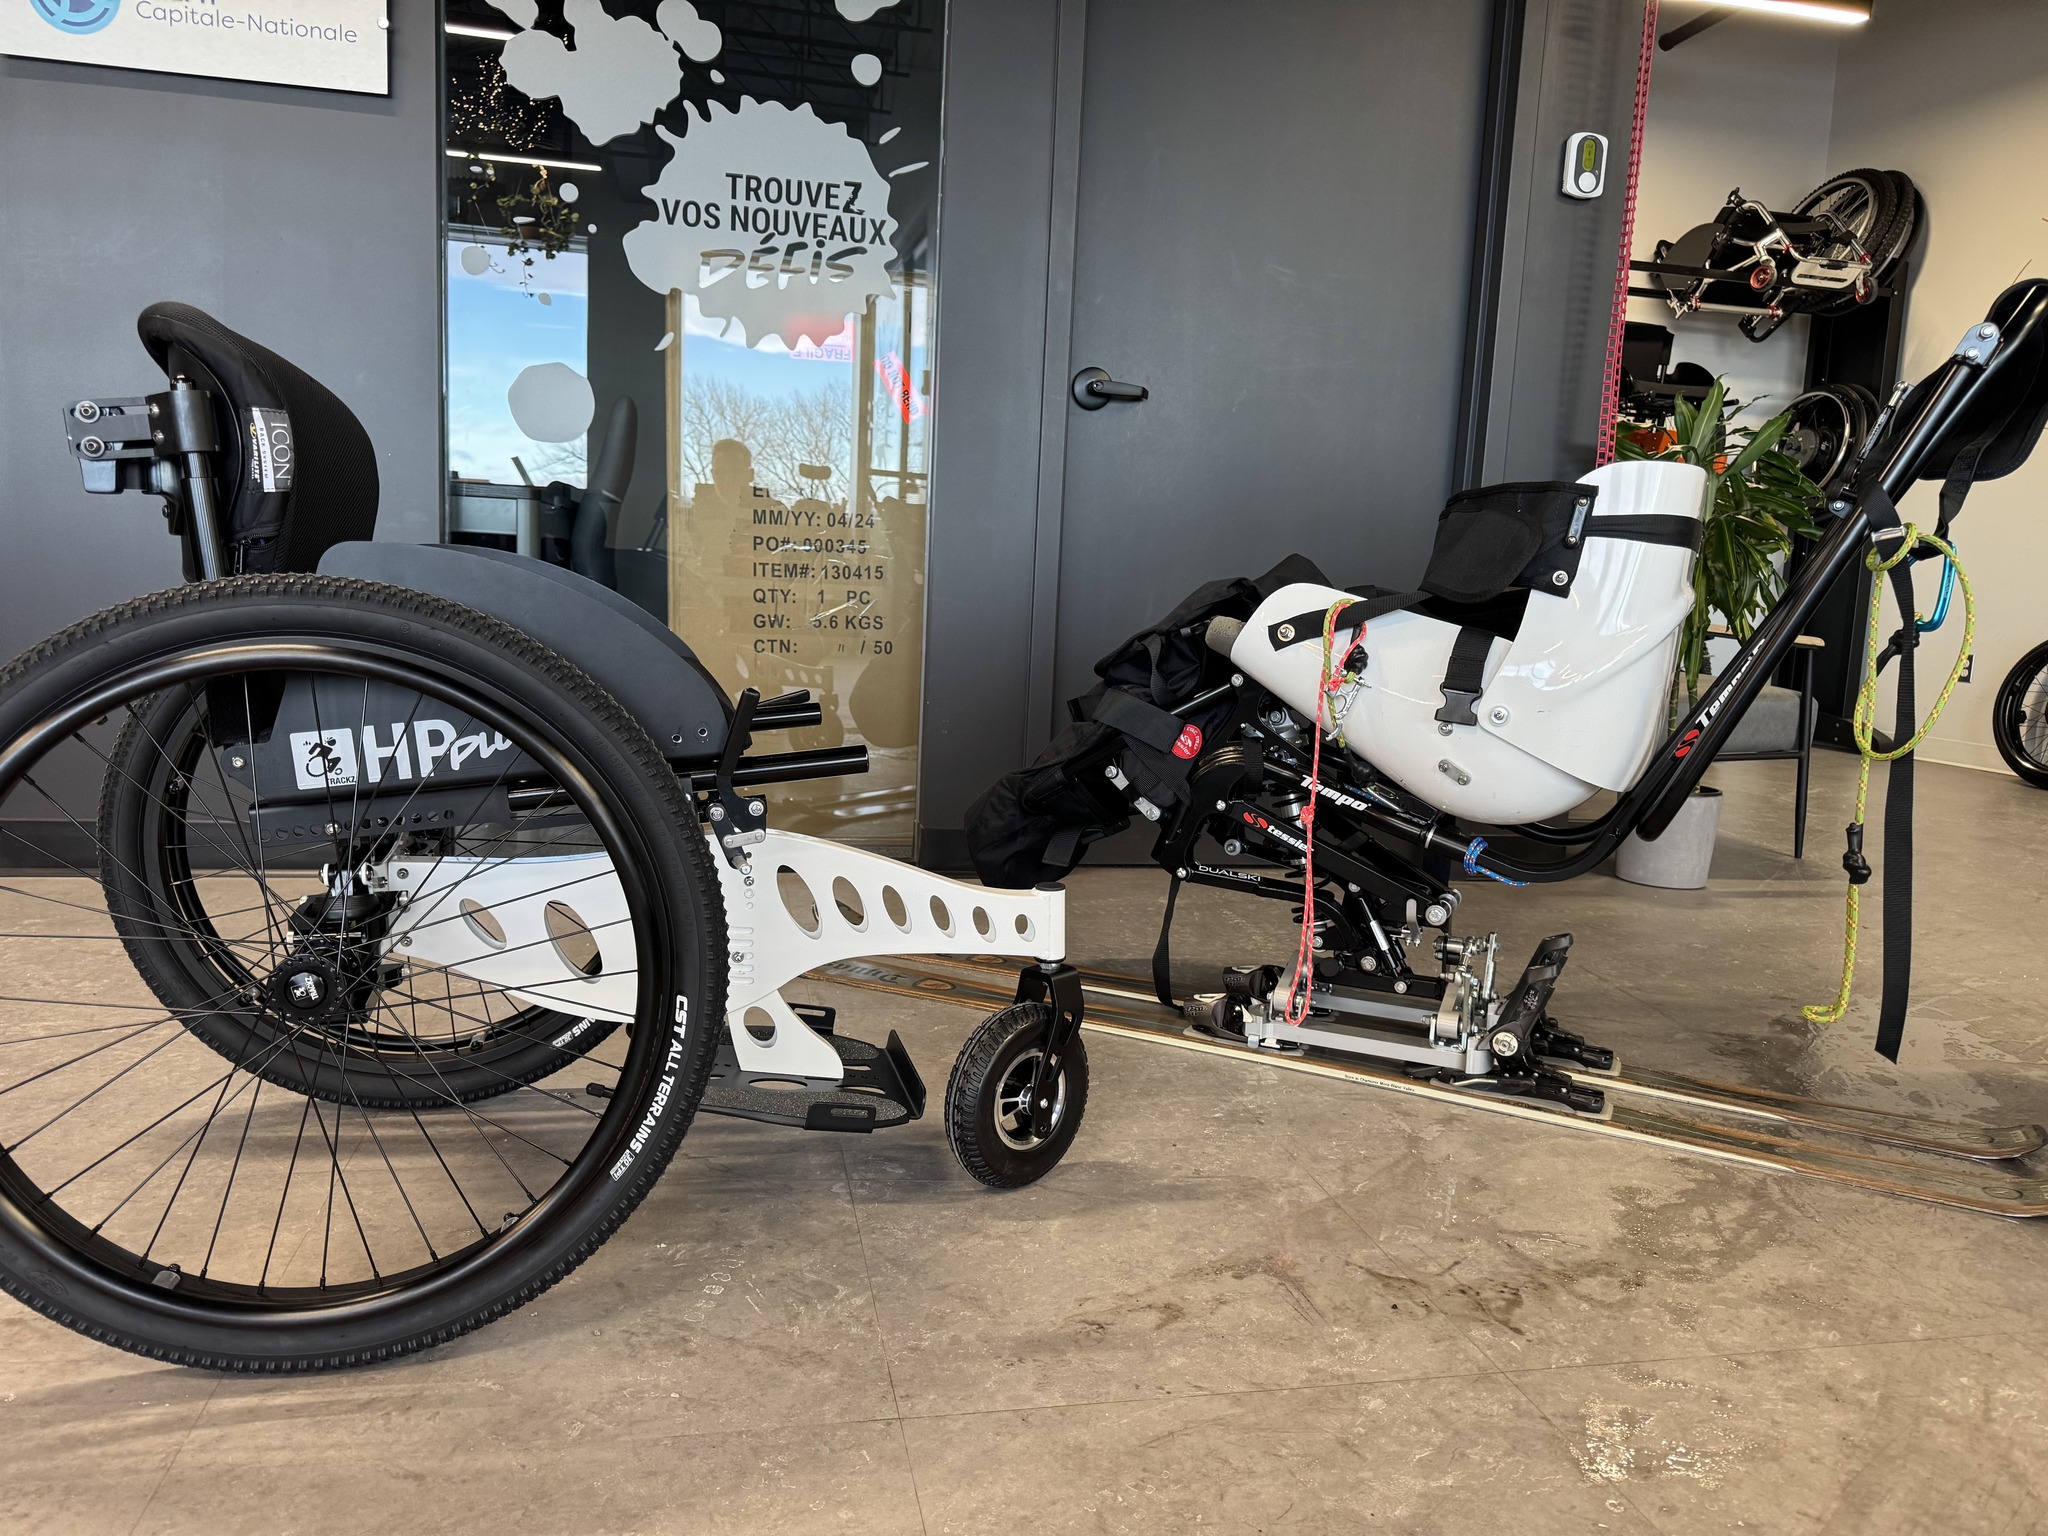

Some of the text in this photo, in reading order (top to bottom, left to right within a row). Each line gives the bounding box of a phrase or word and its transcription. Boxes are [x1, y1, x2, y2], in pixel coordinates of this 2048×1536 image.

[136, 0, 358, 43] Capitale-Nationale
[725, 172, 866, 216] TROUVEZ
[661, 198, 887, 246] VOS NOUVEAUX
[271, 422, 290, 480] ICON
[753, 509, 875, 529] MM/YY: 04/24
[753, 536, 797, 553] PO#:
[753, 562, 884, 580] ITEM#: 130415
[753, 588, 871, 605] QTY: 1 PC
[753, 614, 790, 629] GW:
[845, 615, 884, 630] KGS
[753, 639, 797, 654] CTN:
[874, 641, 893, 655] 50
[327, 775, 357, 785] RACKZ
[1300, 774, 1368, 811] Tempo
[1267, 825, 1315, 853] tessie
[1199, 865, 1261, 882] DUALSKI
[304, 976, 319, 1001] TRACKZ
[629, 994, 688, 1154] CST ALL TERRAINS
